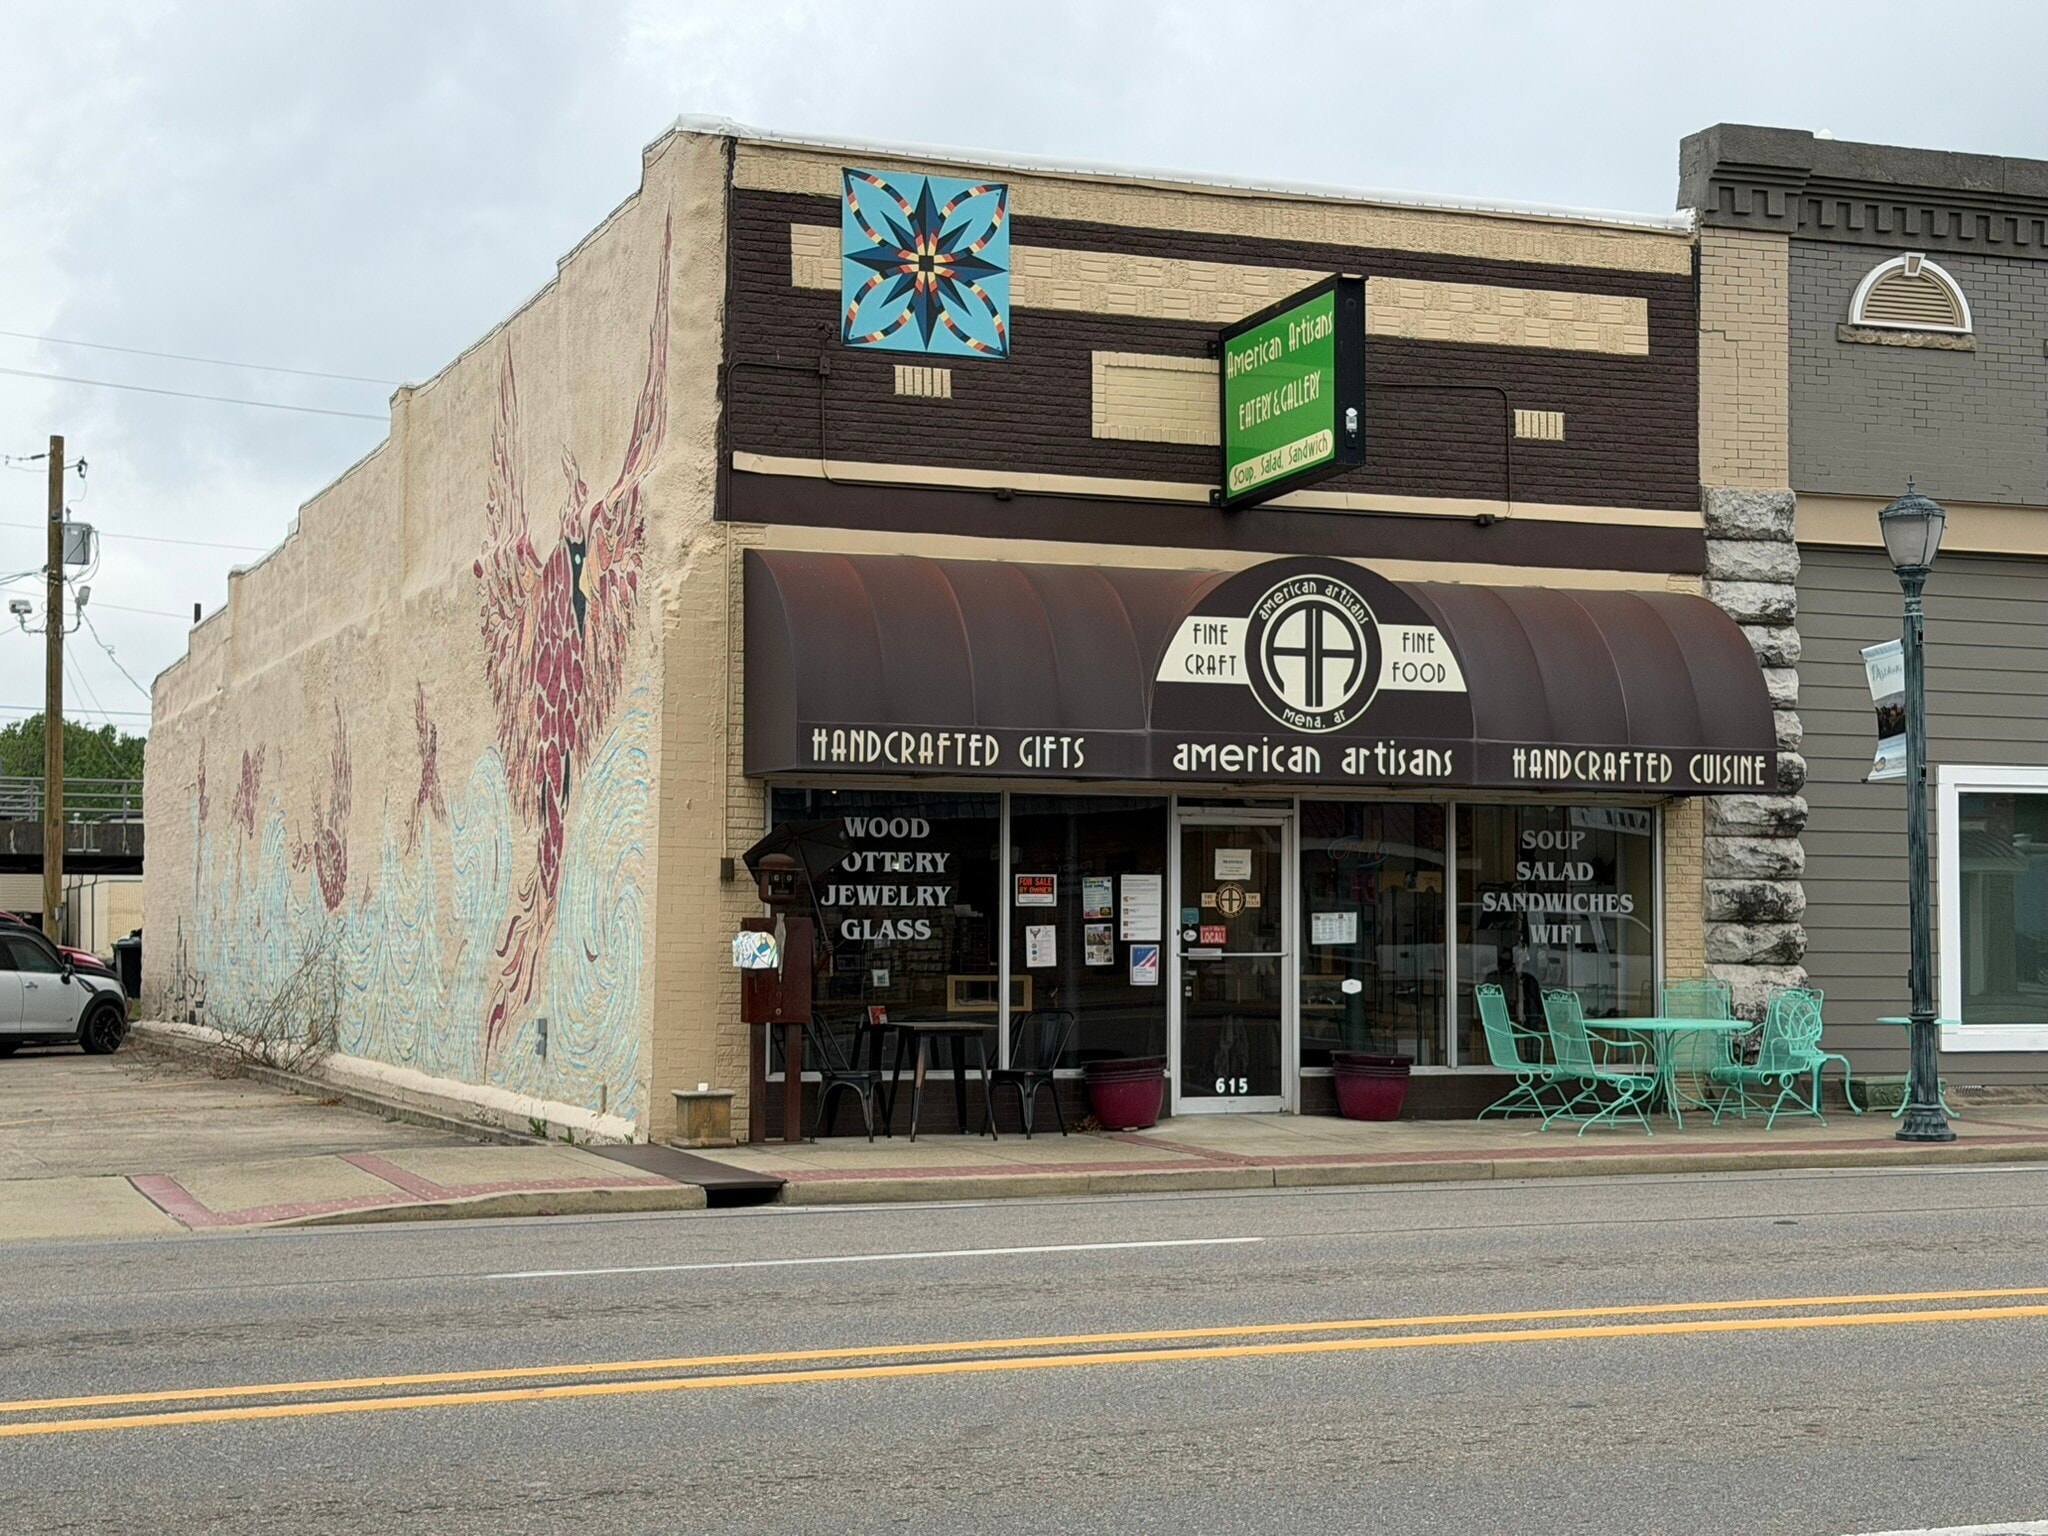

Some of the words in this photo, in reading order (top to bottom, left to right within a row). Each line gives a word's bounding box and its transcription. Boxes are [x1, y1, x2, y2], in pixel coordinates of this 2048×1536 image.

[1226, 337, 1282, 380] American
[1288, 310, 1333, 352] Artisans
[1239, 391, 1272, 431] EATERY
[1280, 369, 1321, 412] GALLERY
[1288, 432, 1328, 465] Sandwich
[1258, 581, 1317, 621] american
[1325, 584, 1369, 625] artisans
[1192, 623, 1228, 646] FINE
[1402, 631, 1436, 655] FINE
[1184, 653, 1237, 677] CRAFT
[1392, 662, 1446, 684] FOOD
[811, 727, 1000, 767] HANDCRAFTED
[1019, 735, 1085, 769] GIFTS
[1172, 736, 1321, 774] american
[1341, 739, 1453, 777] artisans
[1512, 747, 1673, 783] HANDCRAFTED
[1688, 753, 1767, 786] CUISINE
[843, 816, 931, 839] WOOD
[1521, 830, 1586, 851] SOUP
[831, 851, 951, 873] OTTERY
[1516, 861, 1594, 882] SALAD
[1019, 877, 1033, 886] FOR
[1035, 877, 1053, 886] SALE
[820, 884, 952, 907] JEWELRY
[1482, 891, 1634, 914] SANDWICHES
[841, 918, 932, 940] GLASS
[1529, 924, 1582, 944] WIFI
[1215, 1077, 1248, 1094] 615
